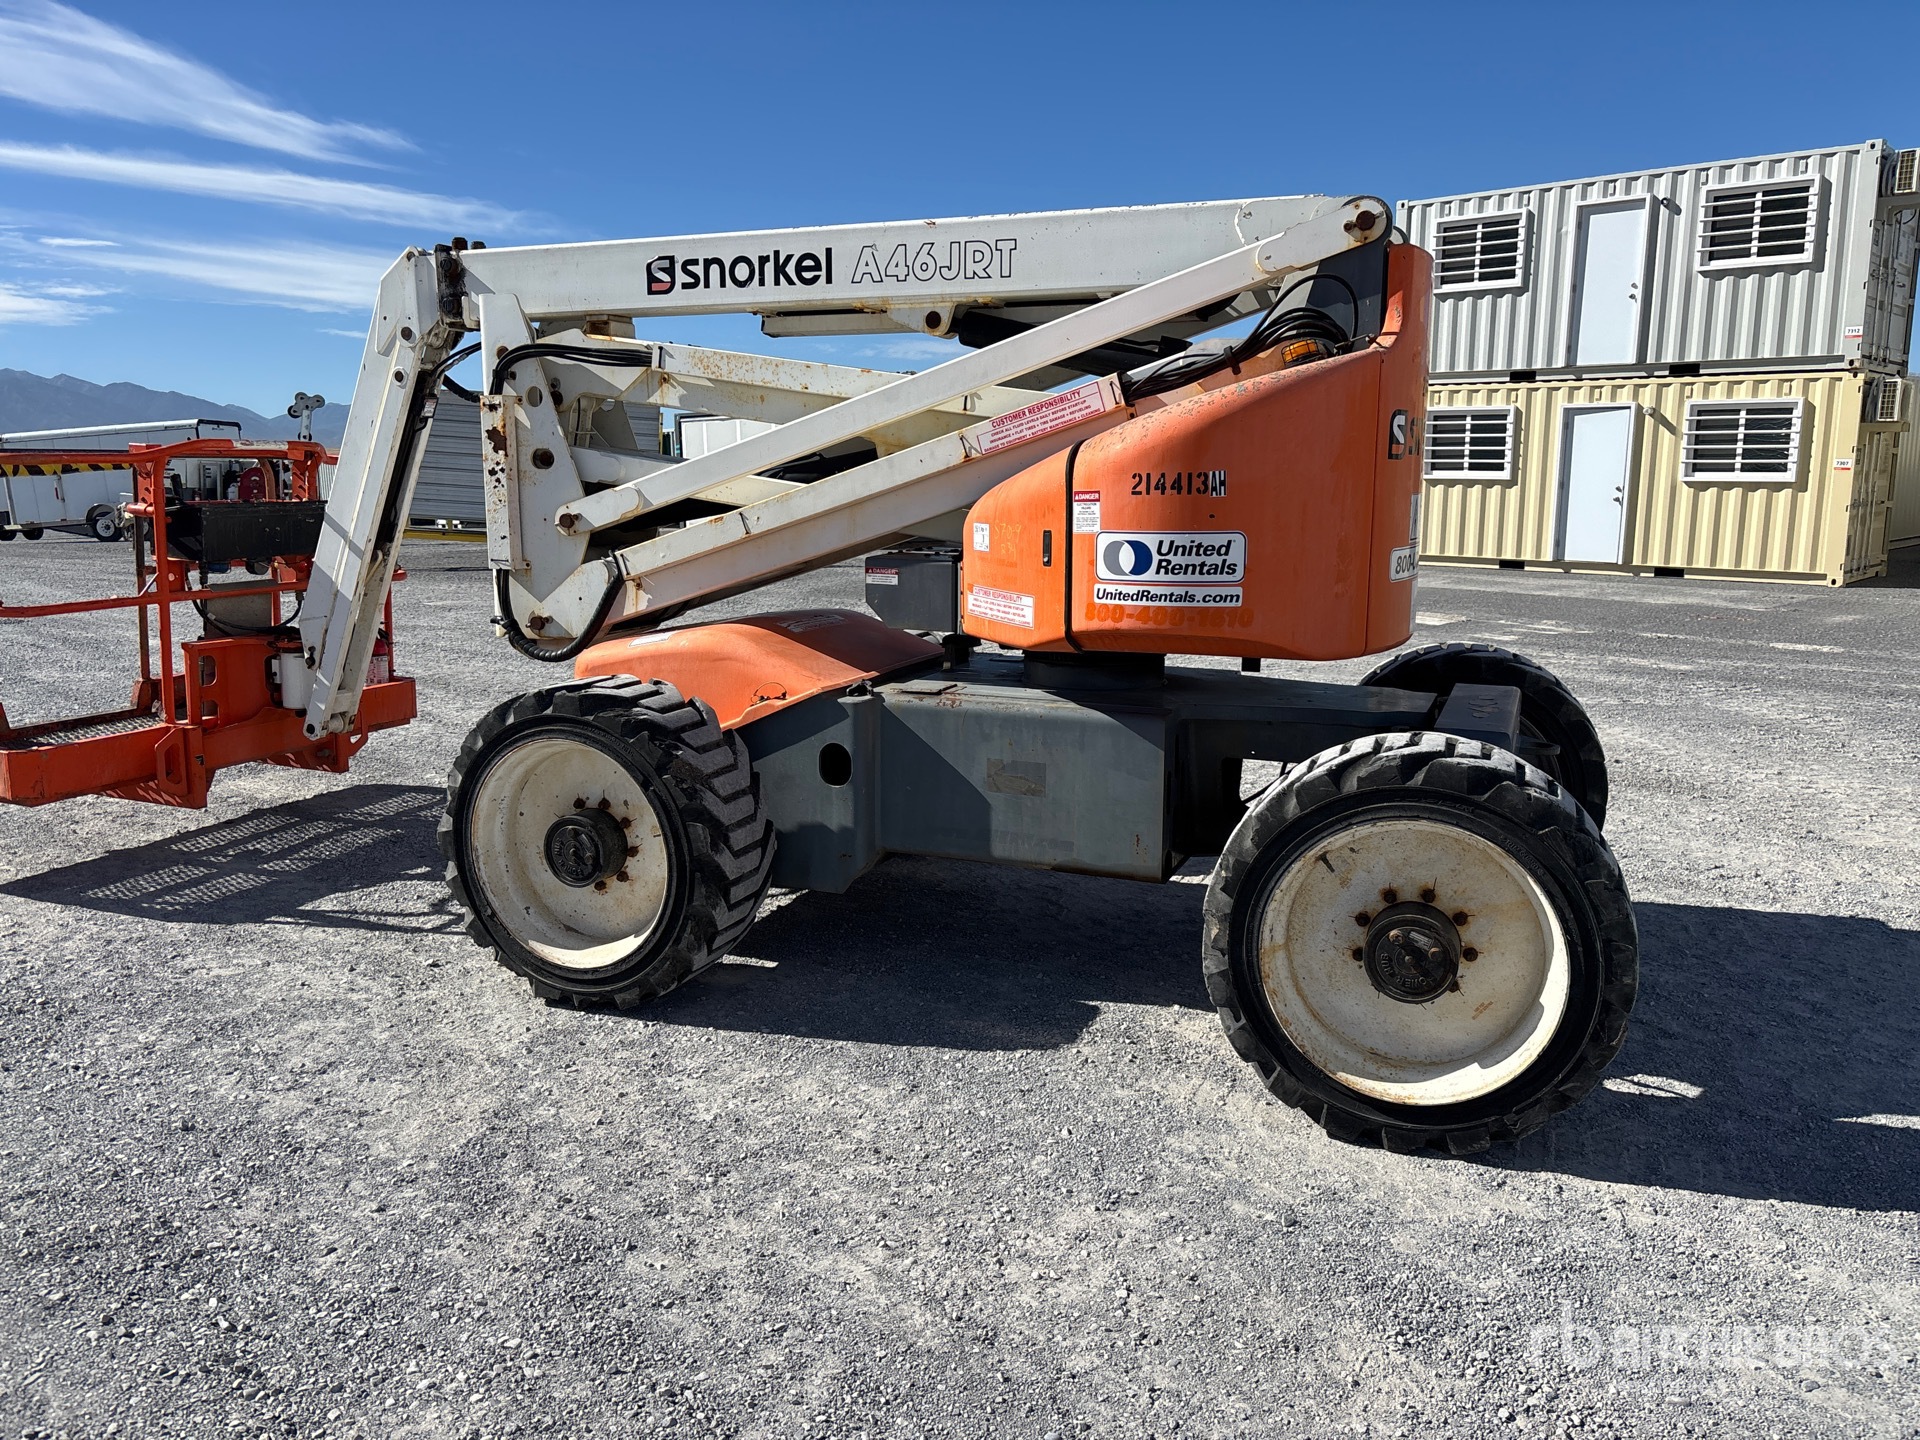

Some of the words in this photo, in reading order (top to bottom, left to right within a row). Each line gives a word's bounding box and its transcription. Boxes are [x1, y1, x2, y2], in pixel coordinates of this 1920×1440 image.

[681, 247, 833, 289] snorkel
[851, 238, 1017, 284] A46JRT
[992, 410, 1026, 428] CUSTOMER
[1028, 390, 1081, 415] RESPONSIBILITY
[1024, 417, 1039, 425] LEVELS
[1052, 407, 1066, 415] BEFORE
[1068, 400, 1086, 409] START-UP
[990, 434, 1011, 444] INSURANCE
[1040, 419, 1048, 427] TIRE
[1049, 414, 1065, 422] DAMAGE
[1070, 405, 1091, 415] REFUELING
[1032, 427, 1048, 435] BATTERY
[1049, 417, 1076, 429] MAINTENANCE
[1155, 540, 1232, 557] United
[1154, 559, 1238, 576] Rentals
[1096, 588, 1240, 603] UnitedRentals.com
